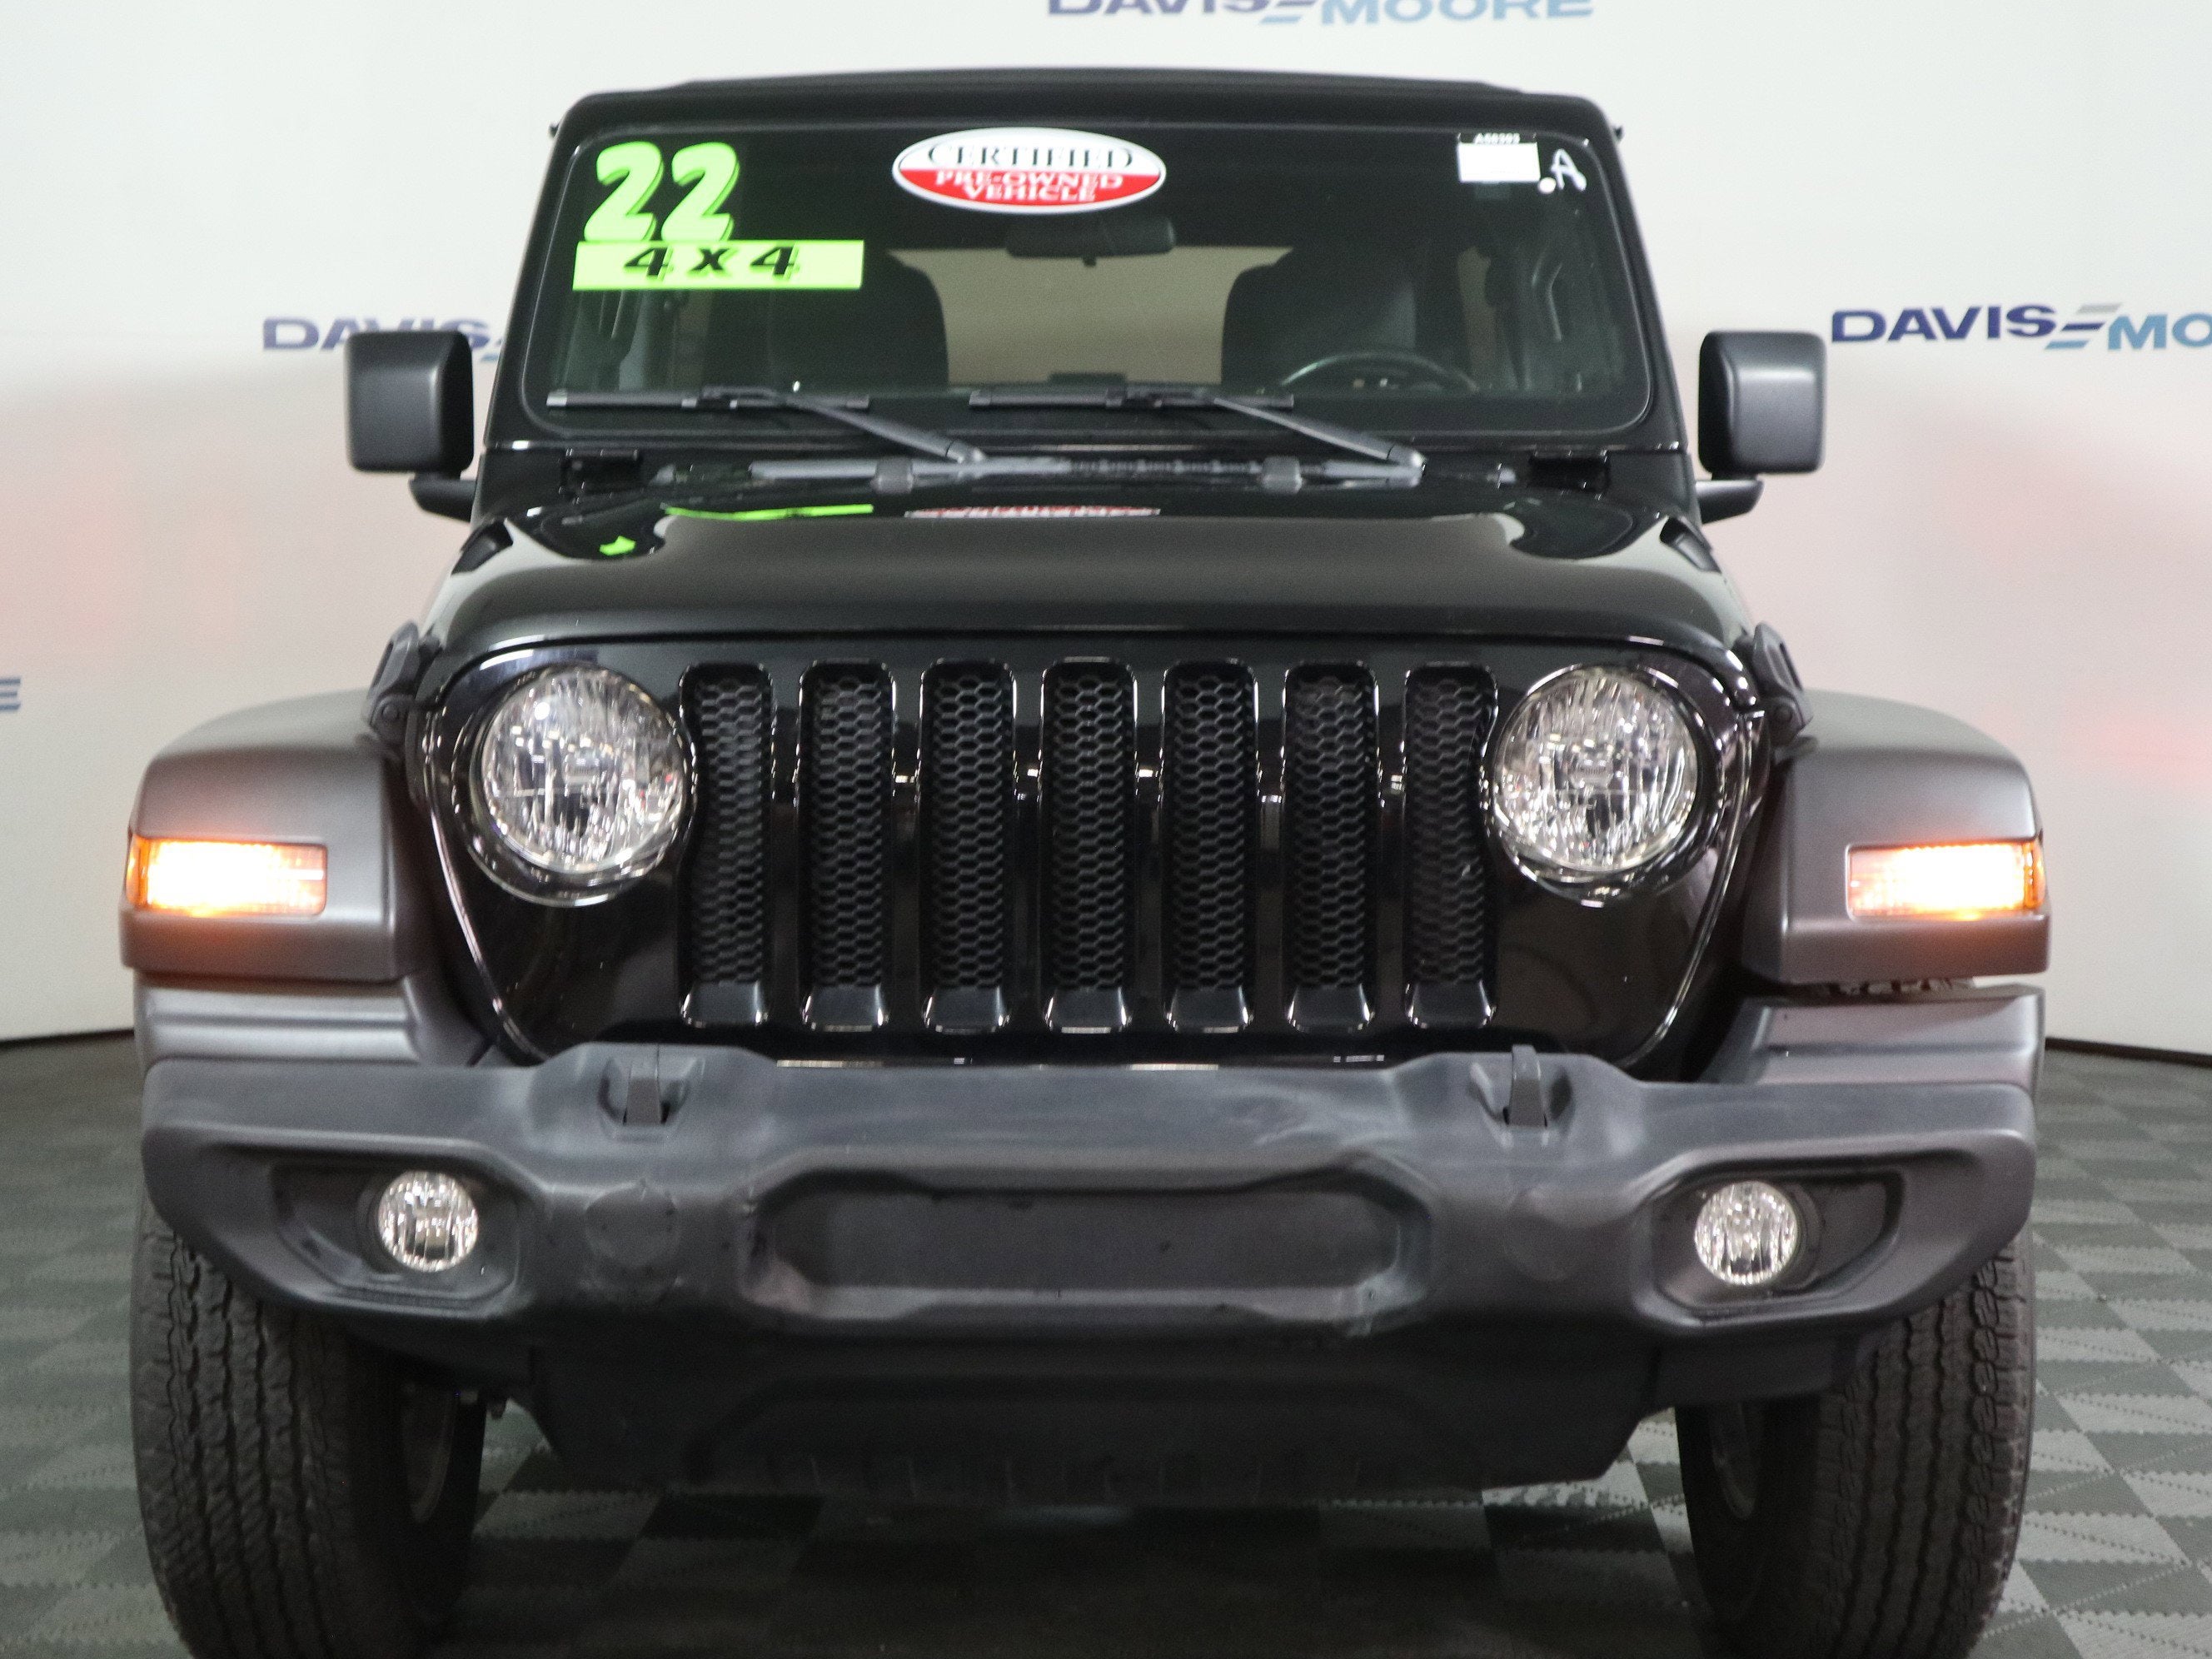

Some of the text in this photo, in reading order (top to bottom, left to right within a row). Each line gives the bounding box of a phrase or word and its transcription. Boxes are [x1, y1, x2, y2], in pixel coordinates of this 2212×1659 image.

[928, 144, 1133, 170] CERTIFIED
[584, 141, 740, 242] 22
[935, 169, 1124, 191] PRE-OWNED
[963, 183, 1098, 202] VEHICLE
[1831, 304, 2057, 343] DAVIS
